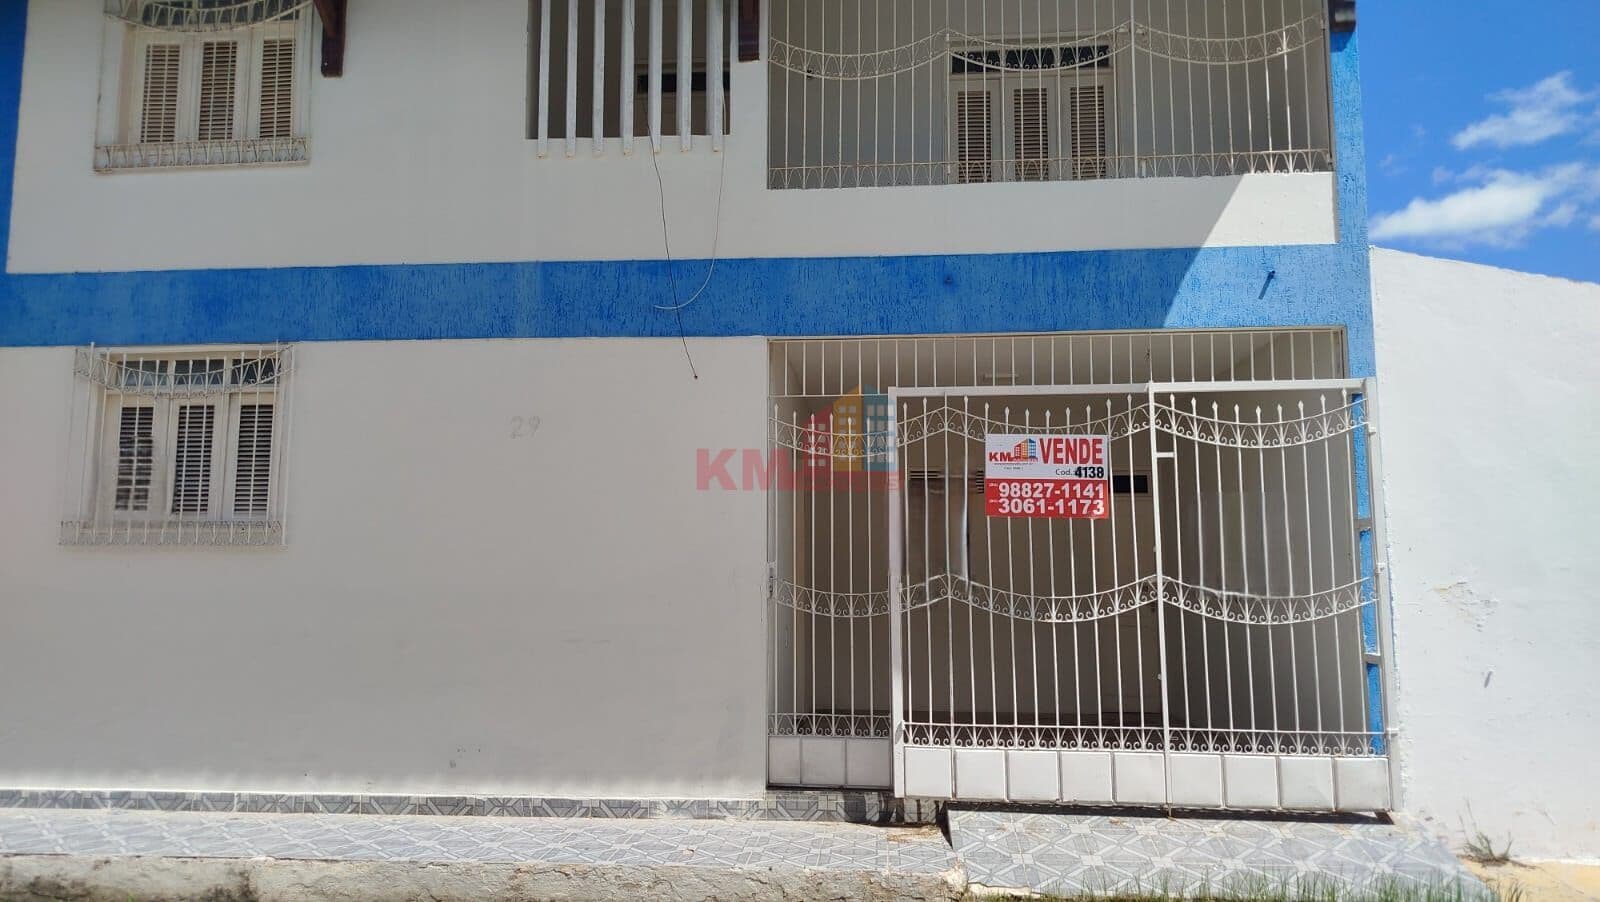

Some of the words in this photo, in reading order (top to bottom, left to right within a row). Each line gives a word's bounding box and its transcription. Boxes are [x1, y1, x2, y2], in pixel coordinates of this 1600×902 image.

[1039, 438, 1104, 465] VENDE
[1074, 466, 1105, 479] 4138
[998, 482, 1104, 499] 98827-1141
[998, 498, 1105, 515] 3061-1173
